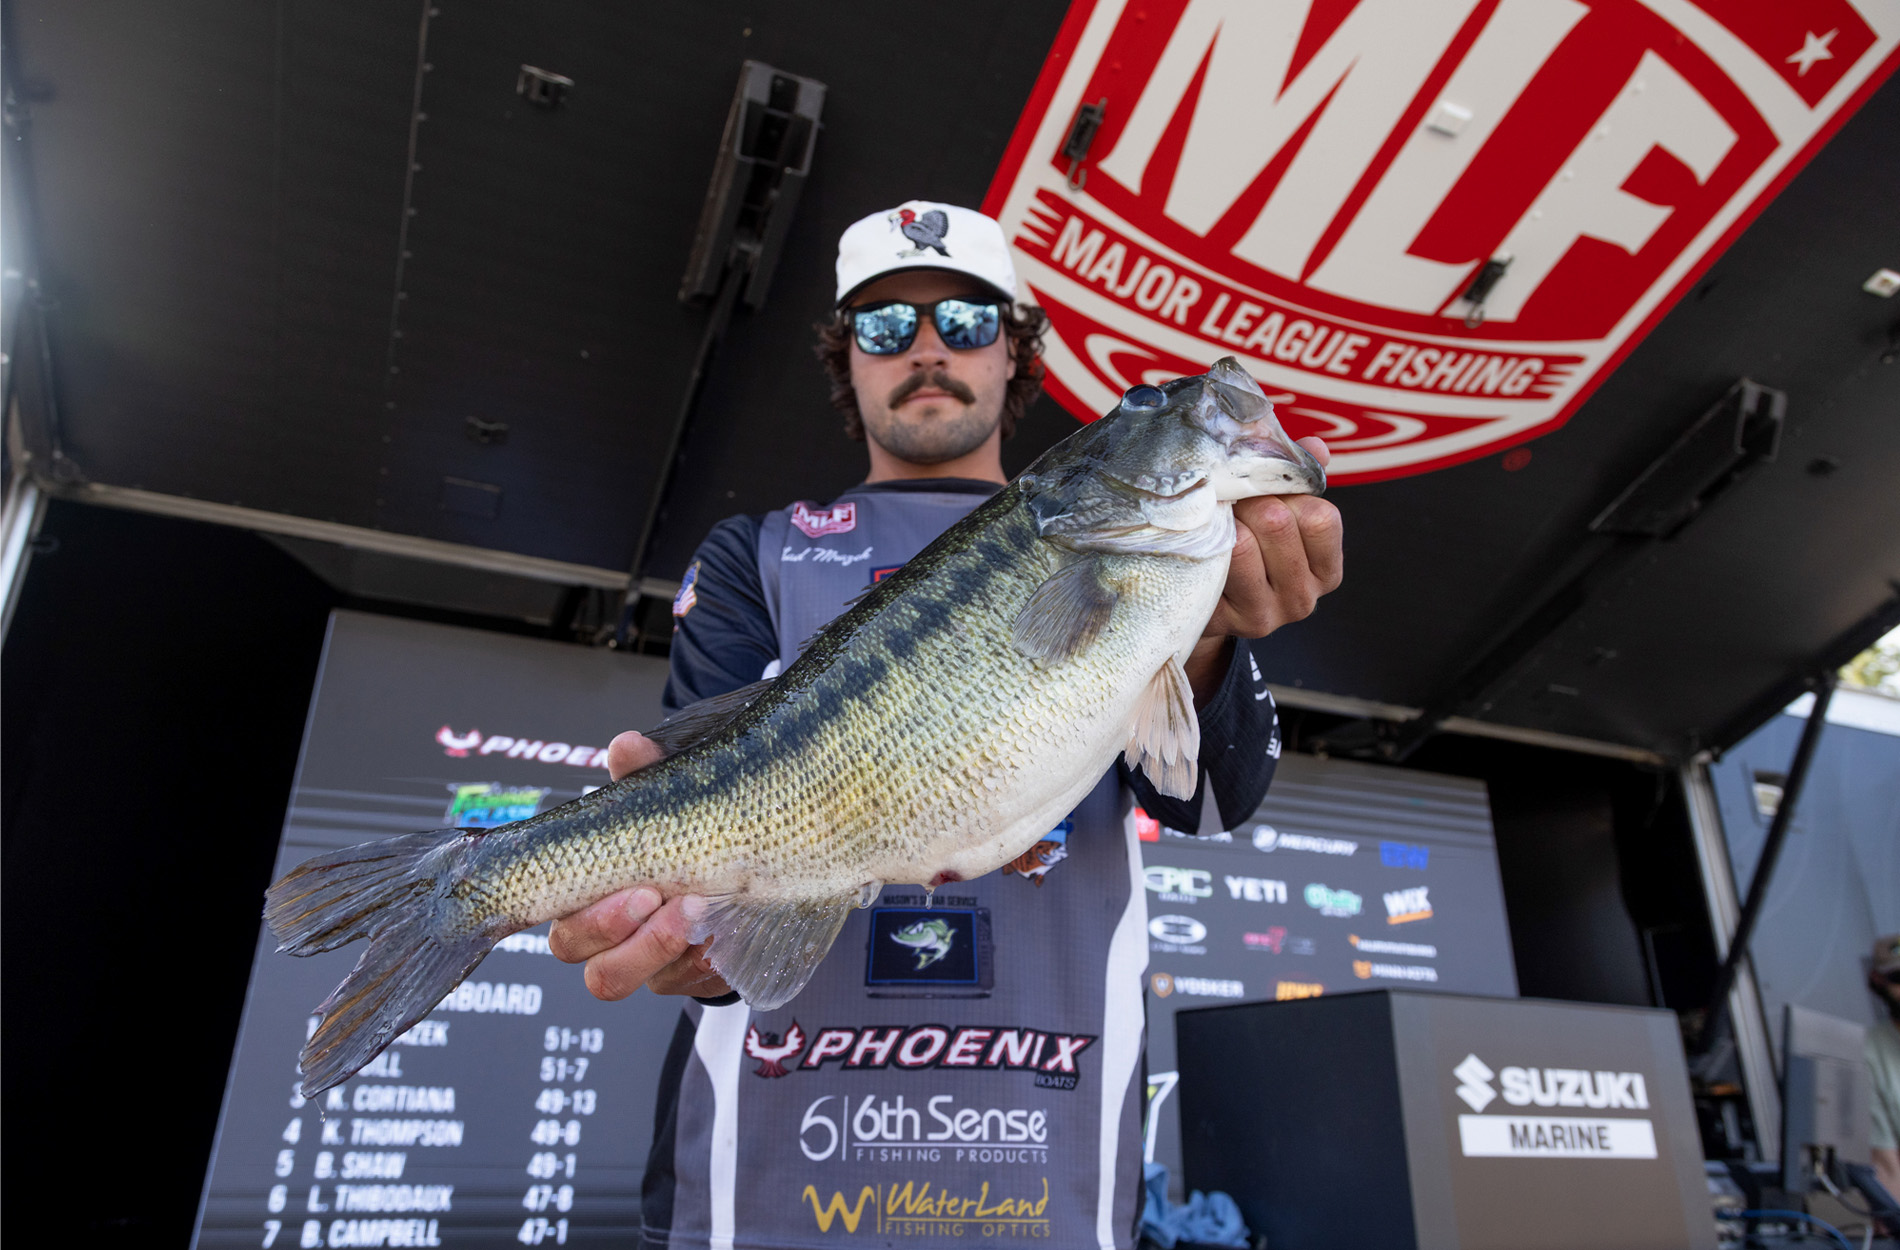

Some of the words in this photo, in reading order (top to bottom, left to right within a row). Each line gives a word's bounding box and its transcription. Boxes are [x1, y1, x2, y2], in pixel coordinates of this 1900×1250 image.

[1098, 0, 1739, 322] MLF
[1050, 216, 1202, 324] MAJOR
[1200, 293, 1371, 374] LEAGUE
[1362, 341, 1545, 396] FISHING
[478, 735, 609, 769] PHOEN
[1225, 875, 1289, 904] YETI
[544, 1025, 604, 1053] 51-13
[802, 1026, 1090, 1073] PHOENIX
[540, 1056, 590, 1082] 51-7
[1036, 1074, 1077, 1090] BOATS
[535, 1087, 597, 1115] 49-13
[1500, 1066, 1649, 1109] SUZUKI
[282, 1117, 303, 1145] 4
[351, 1118, 465, 1147] THOMPSON
[852, 1094, 921, 1141] 6th
[927, 1095, 1048, 1143] Sense
[1509, 1123, 1610, 1150] MARINE
[275, 1149, 295, 1178] 5
[527, 1152, 576, 1180] 49-1
[856, 1149, 941, 1162] FISHING
[956, 1150, 1048, 1164] PRODUCTS
[268, 1184, 288, 1213] 6
[307, 1184, 329, 1213] L.
[886, 1176, 1050, 1217] WaterLand
[262, 1219, 283, 1249] 7
[328, 1218, 441, 1248] CAMPBELL
[517, 1217, 569, 1246] 47-1
[885, 1222, 965, 1237] FISHING
[981, 1223, 1051, 1237] OPTICS
